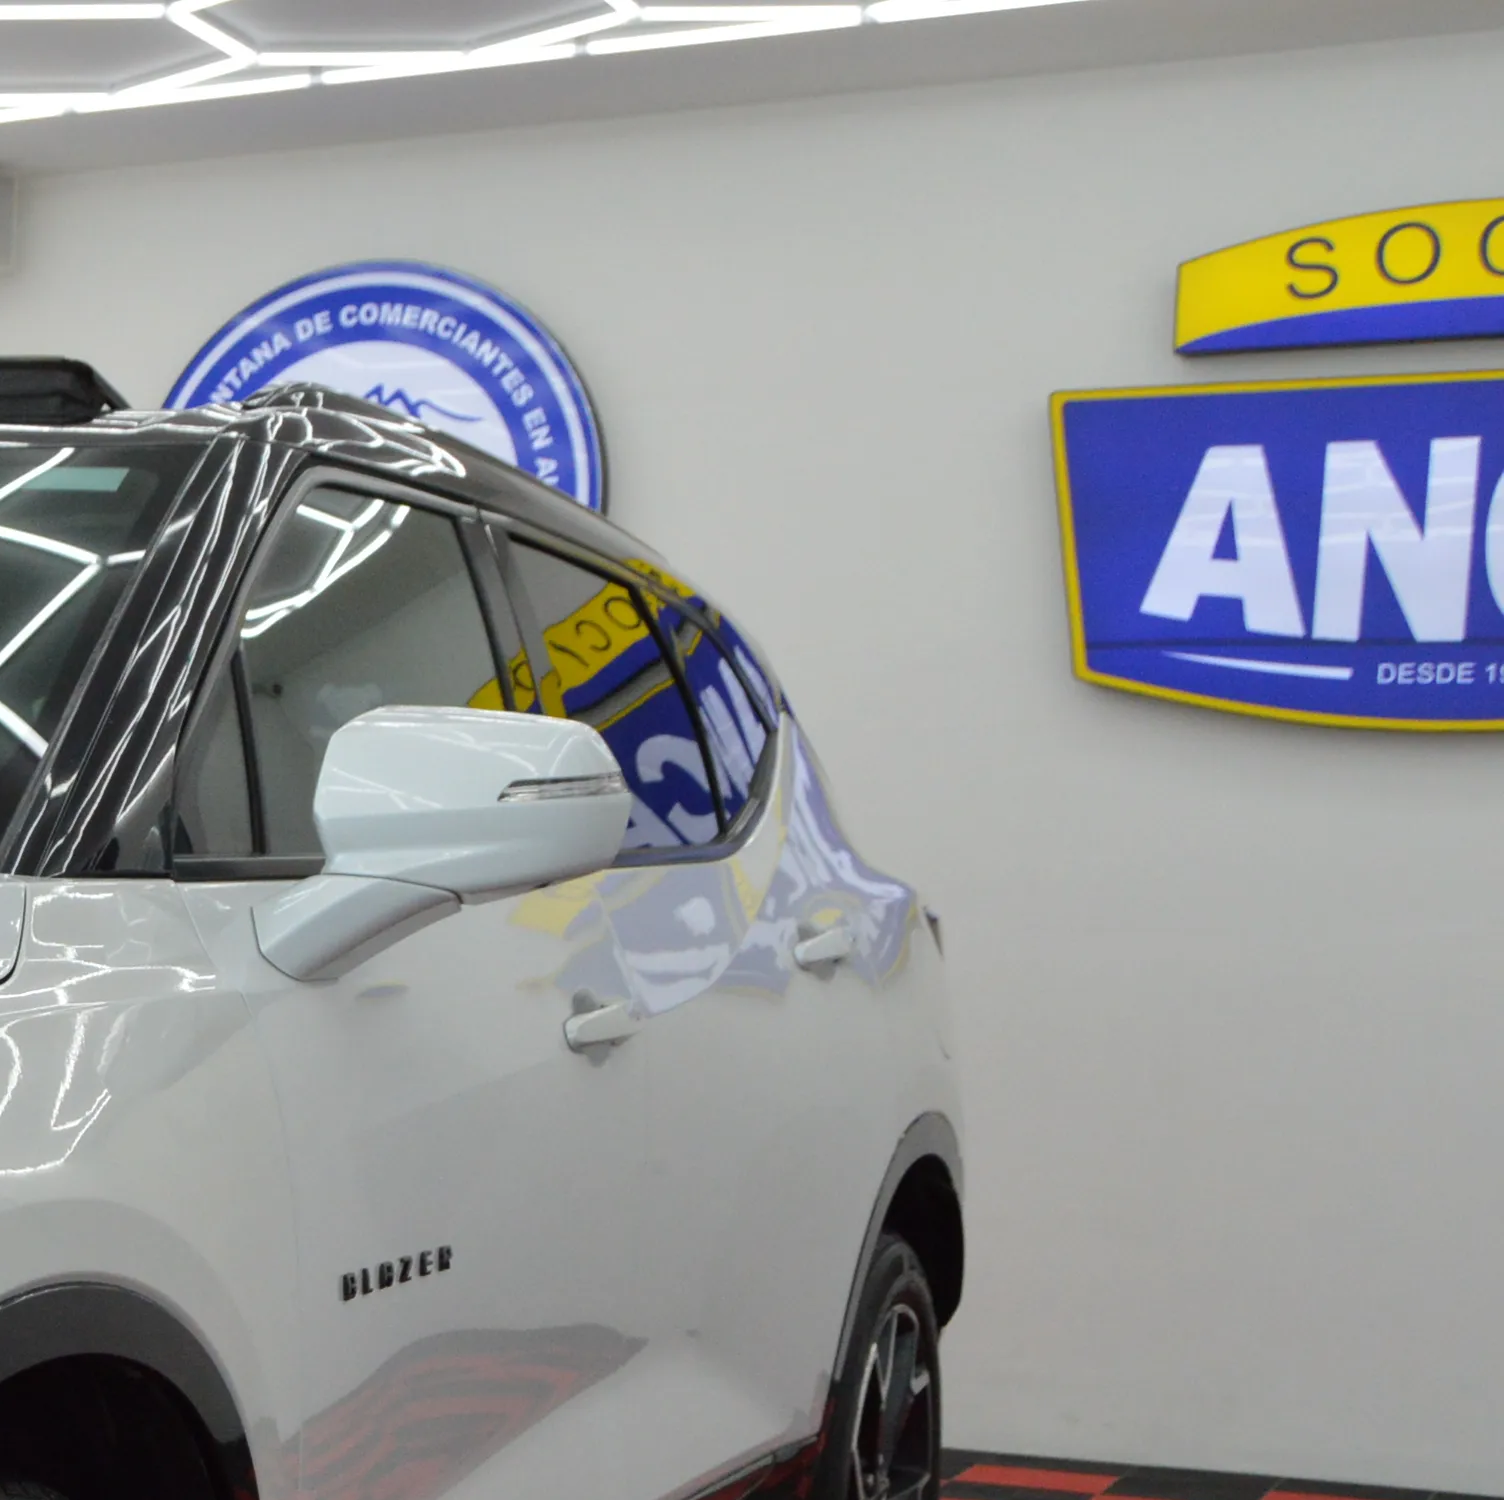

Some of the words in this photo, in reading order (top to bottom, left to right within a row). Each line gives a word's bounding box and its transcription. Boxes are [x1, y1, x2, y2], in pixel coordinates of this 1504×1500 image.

[208, 331, 293, 404] NTANA
[293, 309, 334, 343] DE
[338, 301, 535, 407] COMERCIANTES
[522, 406, 554, 452] EN
[1139, 435, 1504, 643] AN
[1376, 661, 1477, 686] DESDE
[342, 1244, 453, 1302] BLAZER
